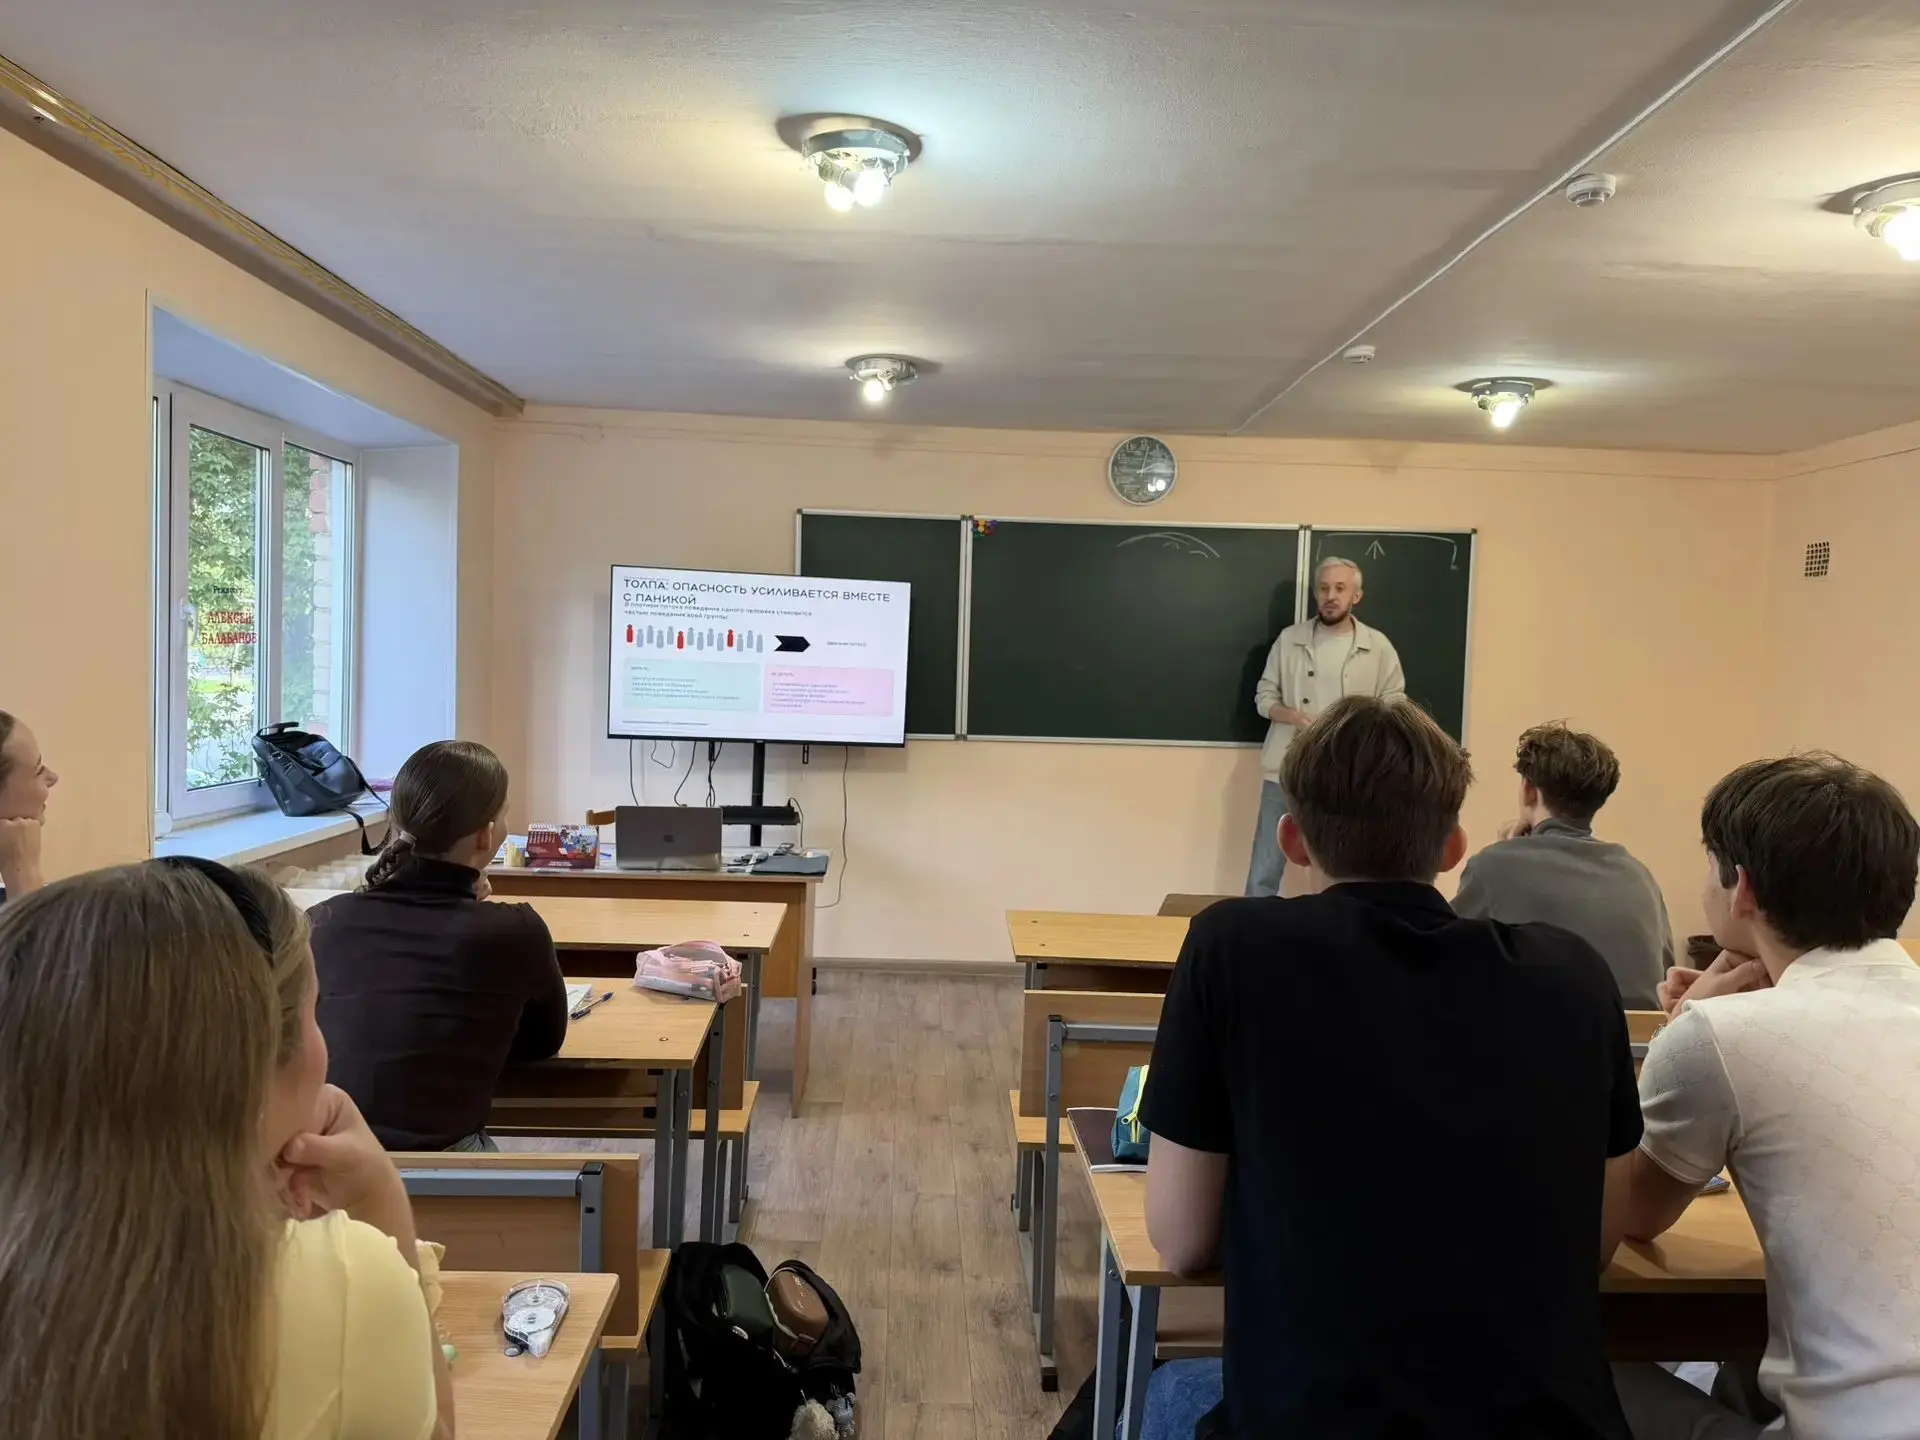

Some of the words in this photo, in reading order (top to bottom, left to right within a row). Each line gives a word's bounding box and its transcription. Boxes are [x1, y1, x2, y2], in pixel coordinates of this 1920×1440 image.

[623, 593, 632, 602] С
[635, 593, 696, 605] ПАНИКОЙ
[624, 579, 669, 591] ТОЛПА:
[672, 582, 747, 595] ОПАСНОСТЬ
[751, 586, 838, 600] УСИЛИВАЕТСЯ
[842, 591, 890, 602] ВМЕСТЕ
